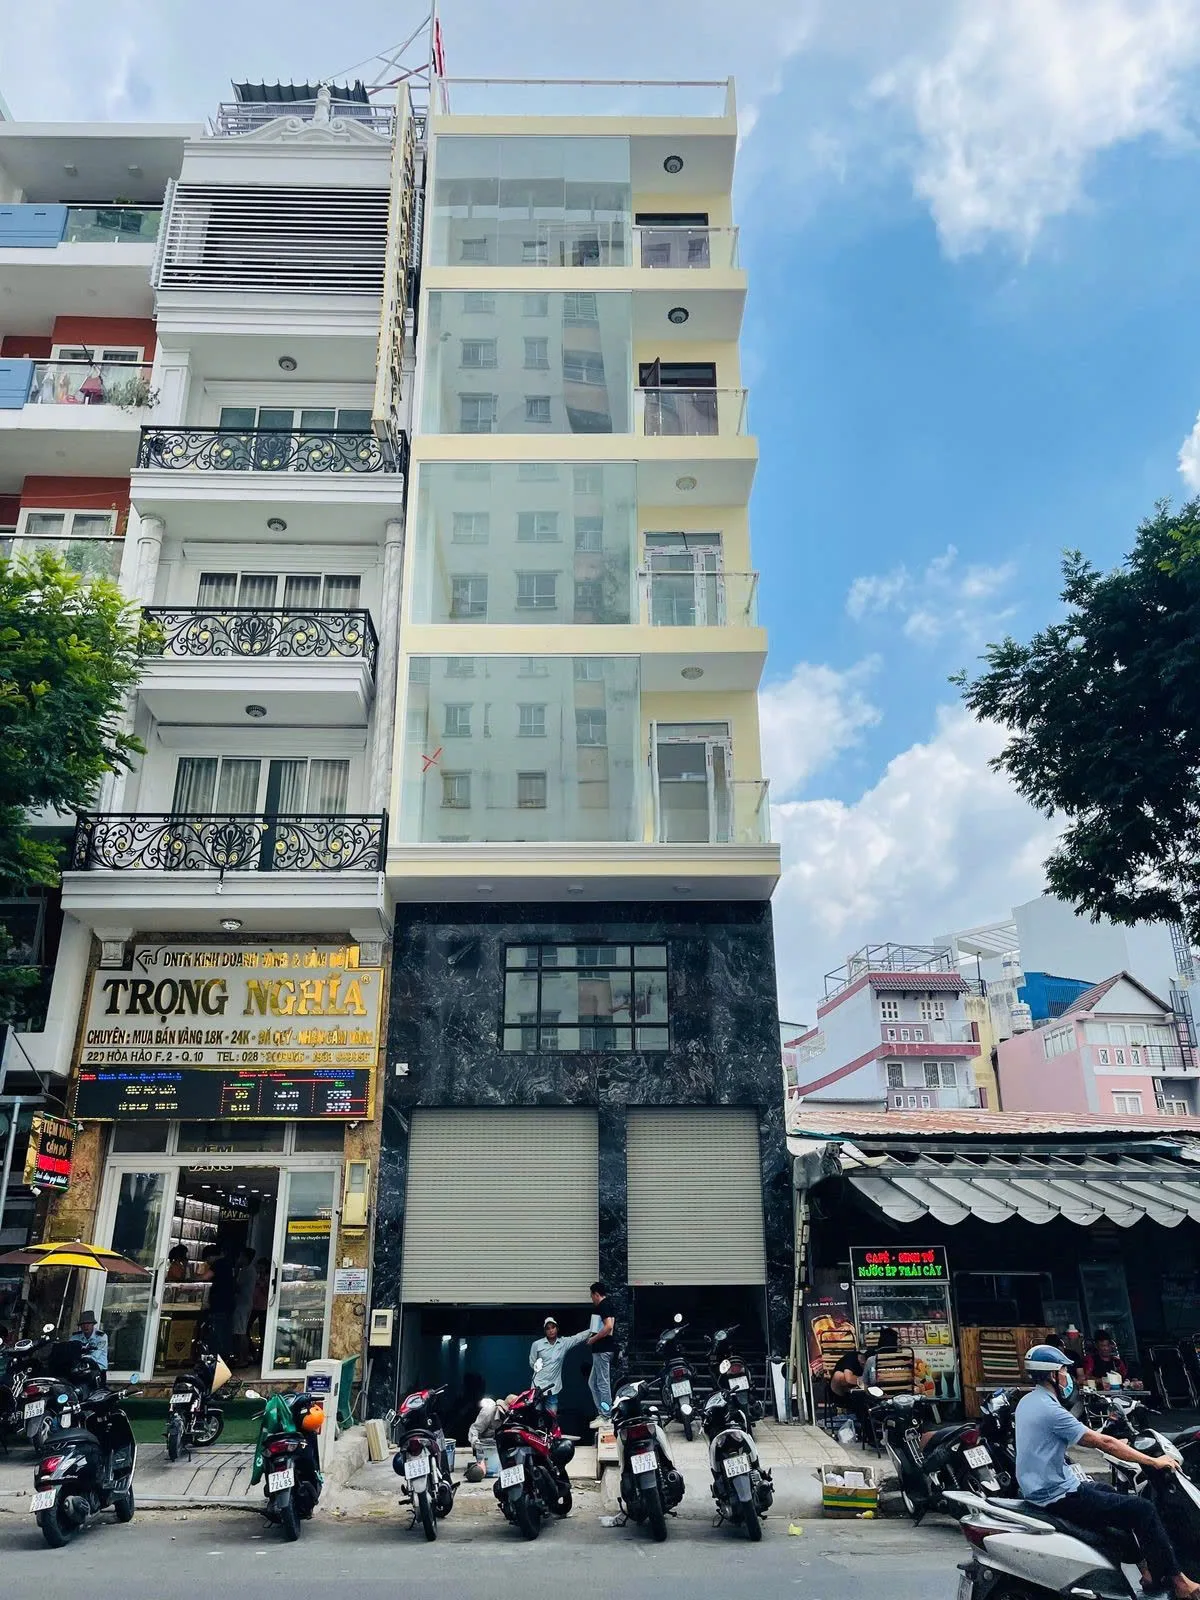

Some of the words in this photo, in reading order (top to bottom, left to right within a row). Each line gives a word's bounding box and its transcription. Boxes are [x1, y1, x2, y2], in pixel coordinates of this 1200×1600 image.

[222, 952, 258, 967] DOANH
[102, 978, 229, 1023] TRỌNG
[243, 972, 367, 1016] NGHĨA
[132, 1029, 154, 1044] MUA
[155, 1027, 176, 1044] BÁN
[178, 1027, 203, 1045] VÀNG
[204, 1030, 224, 1044] 18K
[230, 1030, 251, 1045] 24K
[107, 1048, 128, 1062] HÒA
[130, 1048, 152, 1062] HẢO
[241, 1051, 258, 1062] 028
